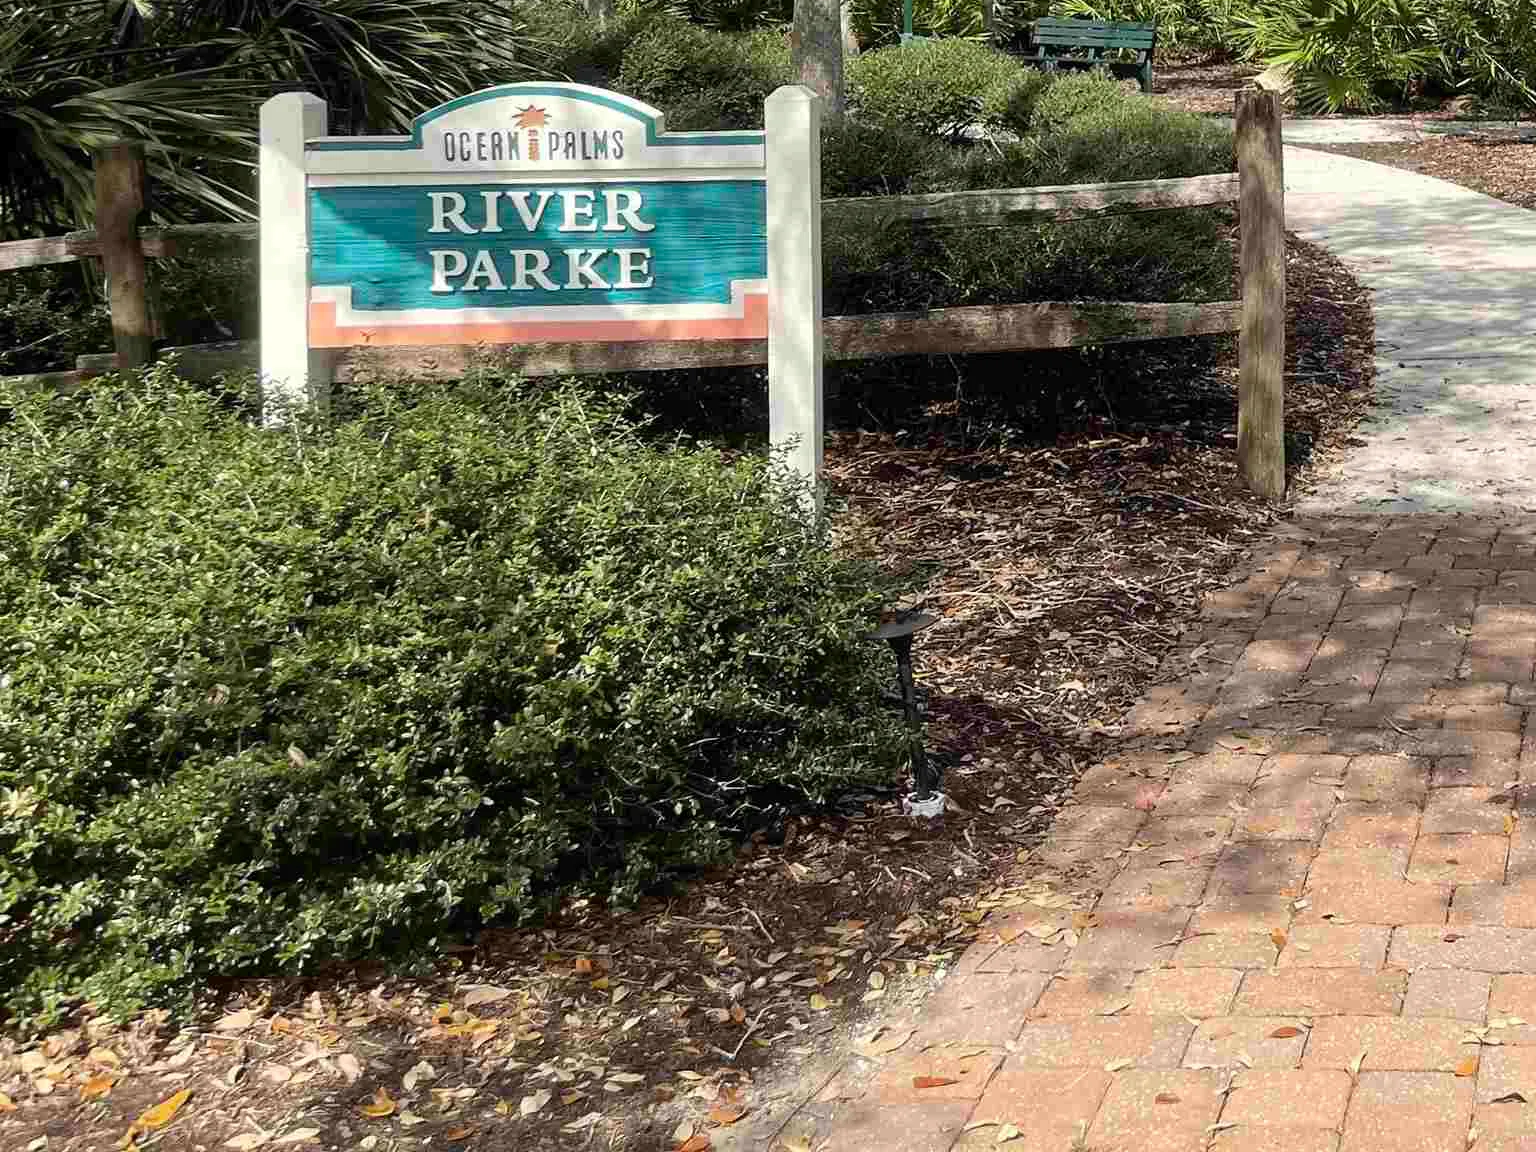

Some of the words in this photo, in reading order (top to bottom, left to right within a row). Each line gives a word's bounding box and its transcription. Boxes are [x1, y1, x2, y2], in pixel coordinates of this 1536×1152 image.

[444, 132, 521, 161] OCEAN
[548, 129, 625, 160] PALMS
[427, 188, 655, 235] RIVER
[429, 247, 655, 294] PARKE
